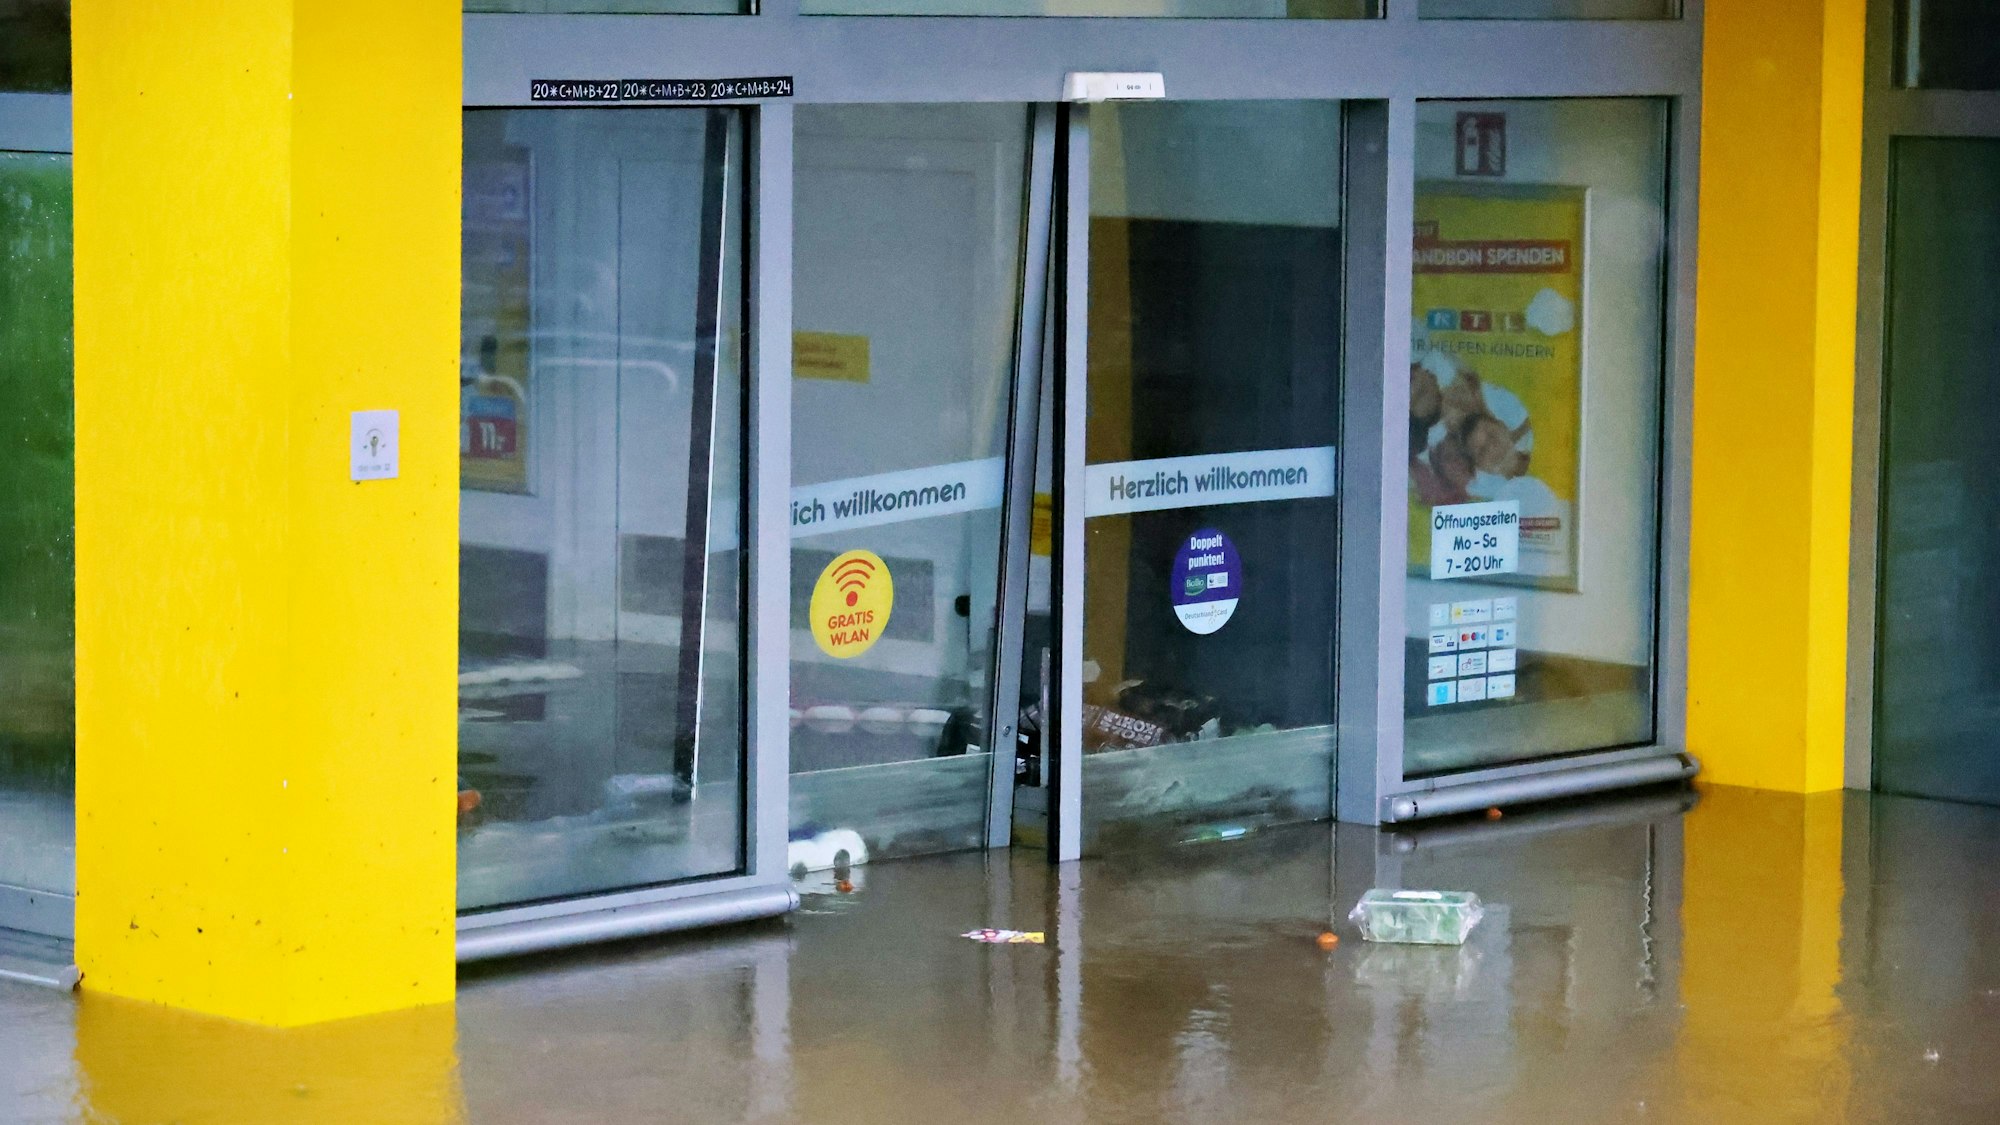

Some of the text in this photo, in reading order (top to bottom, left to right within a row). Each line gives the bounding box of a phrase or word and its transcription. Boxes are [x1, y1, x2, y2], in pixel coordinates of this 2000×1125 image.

[1486, 248, 1565, 266] SPENDEN
[1411, 338, 1555, 358] IR HELFEN KINDERN
[1109, 466, 1307, 501] Herzlich willkommen
[833, 482, 966, 519] willkommen
[1434, 510, 1517, 530] Öffnungszeiten
[1190, 534, 1223, 551] Doppelt
[1453, 536, 1471, 551] Mo
[1483, 533, 1497, 548] Sa
[1188, 552, 1225, 571] punkten!
[1446, 559, 1453, 573] 7
[1464, 557, 1481, 572] 20
[1484, 556, 1504, 571] Uhr
[828, 610, 874, 630] GRATIS
[830, 628, 869, 647] WLAN
